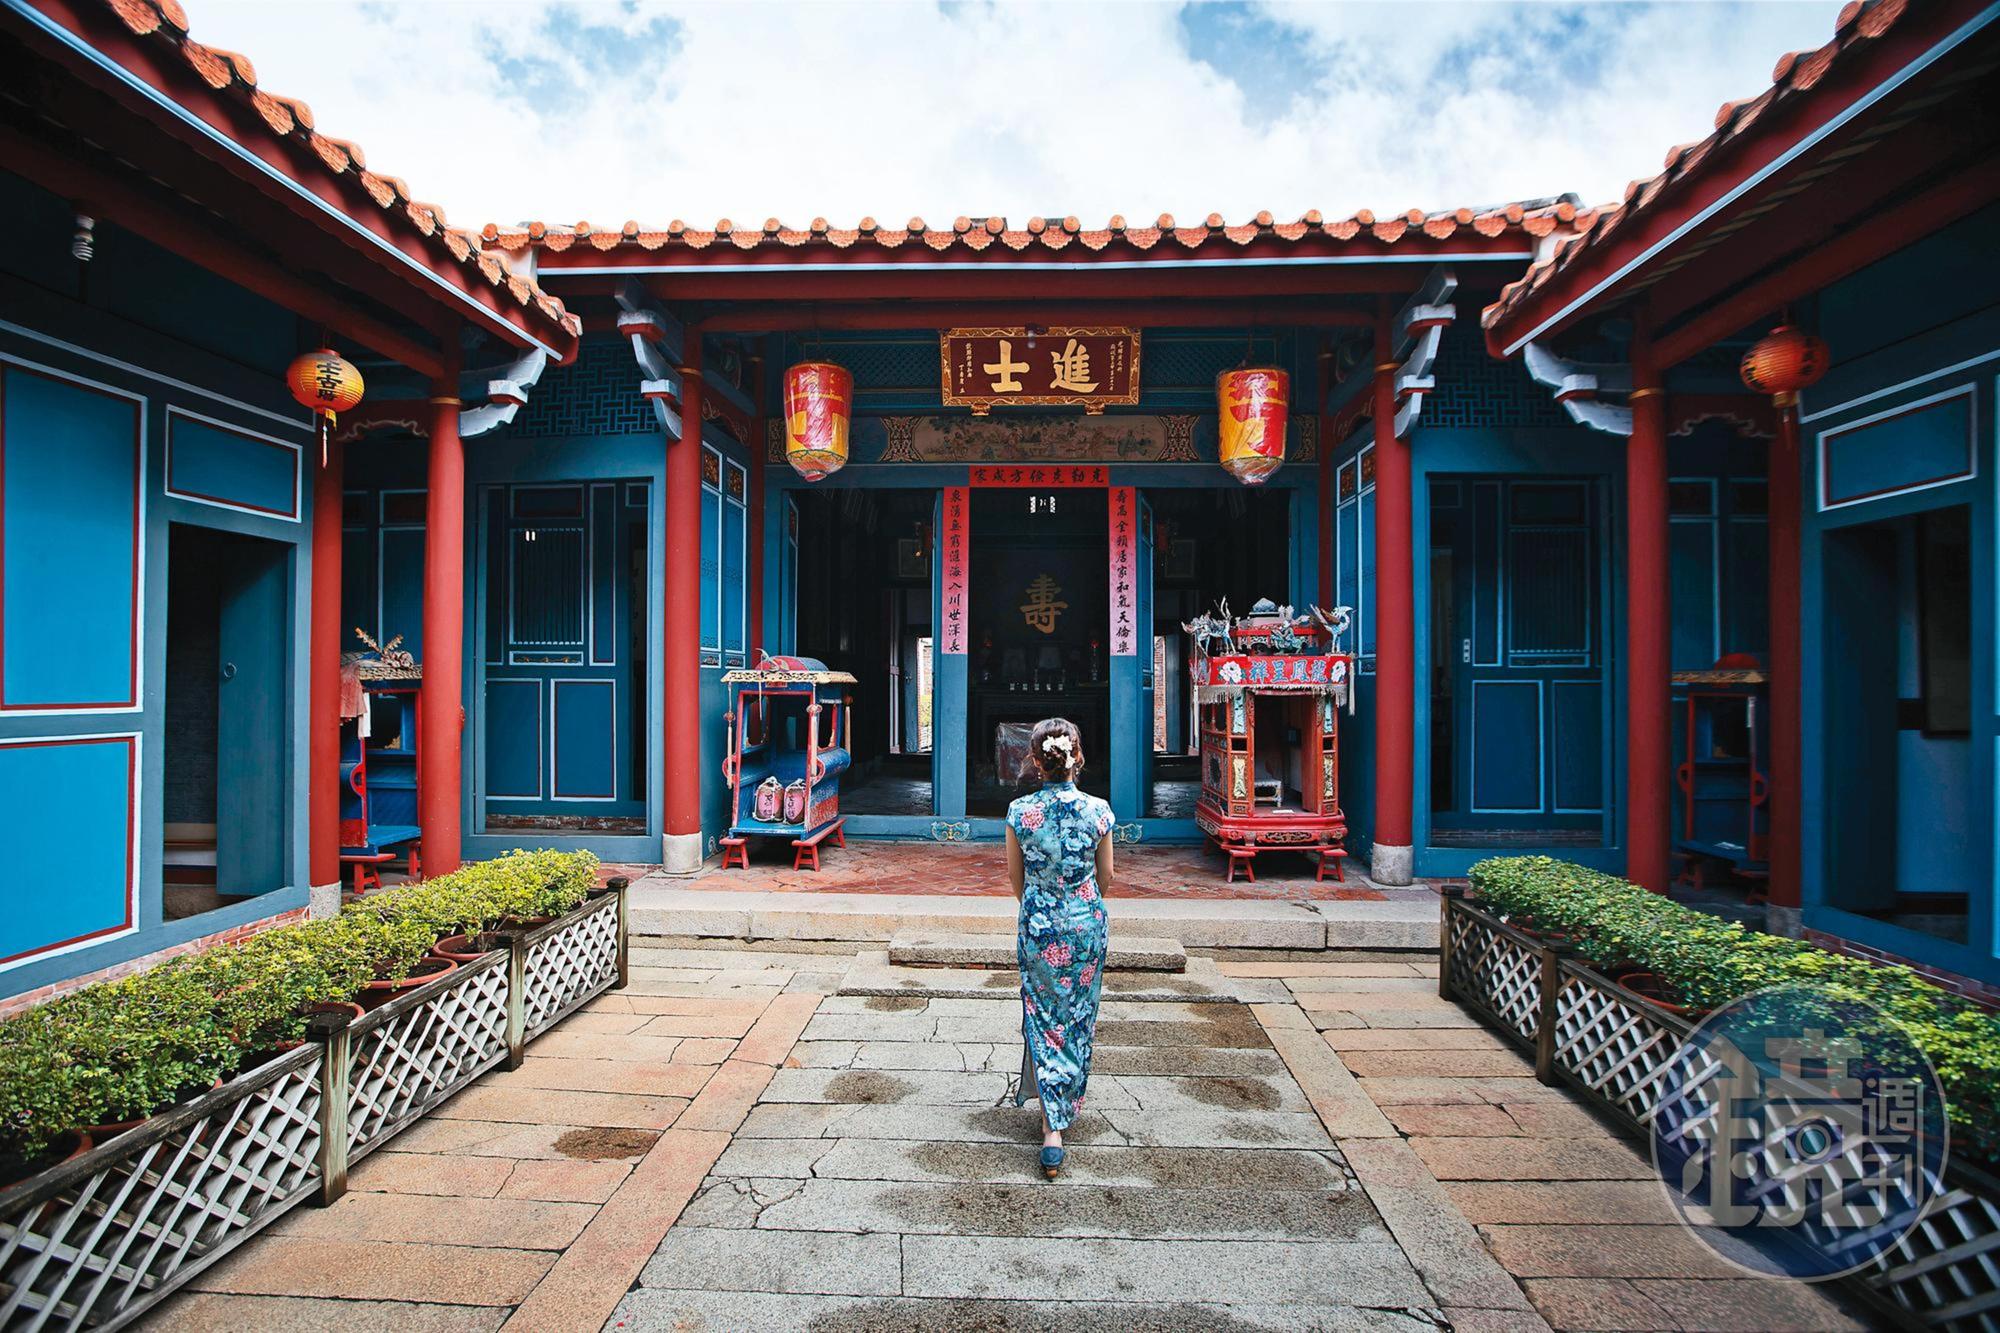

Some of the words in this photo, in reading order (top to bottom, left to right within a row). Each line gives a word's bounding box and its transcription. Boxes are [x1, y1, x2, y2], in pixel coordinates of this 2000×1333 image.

[984, 338, 1100, 393] 進士
[1019, 574, 1068, 634] 壽
[1249, 659, 1328, 684] 龍鳳呈祥
